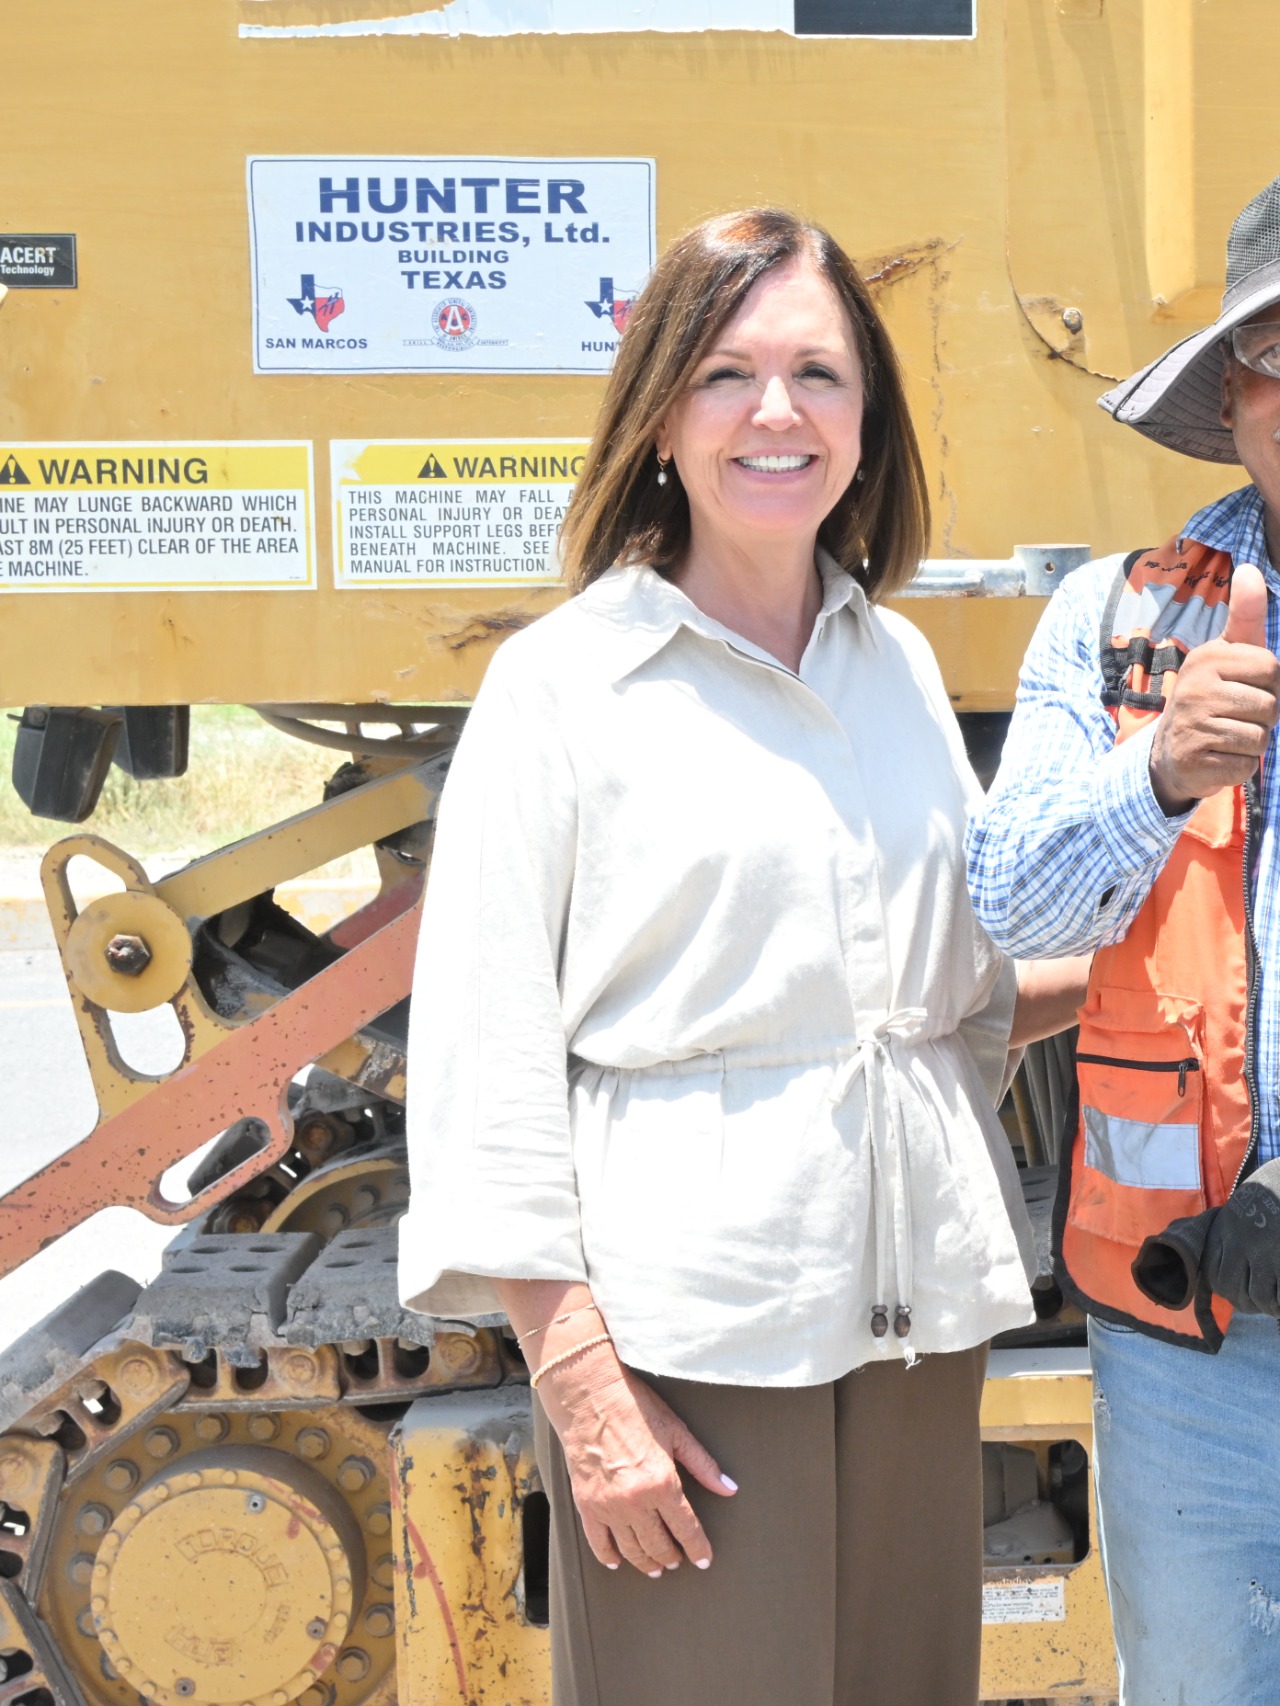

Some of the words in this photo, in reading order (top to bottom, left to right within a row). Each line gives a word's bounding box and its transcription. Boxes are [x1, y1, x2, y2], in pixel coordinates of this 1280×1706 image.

[319, 178, 587, 213] HUNTER
[296, 222, 530, 247] INDUSTRIES,
[545, 222, 609, 243] Ltd.
[0, 246, 57, 263] ACERT
[399, 250, 508, 263] BUILDING
[0, 264, 55, 277] Technology
[401, 271, 506, 289] TEXAS
[266, 338, 296, 348] SAN
[302, 338, 367, 349] MARCOS
[38, 458, 207, 484] WARNING
[0, 497, 25, 513] INE
[35, 497, 68, 512] MAY
[78, 497, 132, 512] LUNGE
[142, 496, 232, 512] BACKWARD
[242, 495, 296, 511] WHICH
[349, 491, 381, 504] THIS
[396, 490, 462, 504] MACHINE
[476, 490, 505, 503] MAY
[520, 490, 554, 502] FALL
[350, 508, 426, 521] PERSONAL
[439, 507, 491, 520] INJURY
[503, 507, 522, 520] OR
[534, 505, 568, 521] DEA
[0, 518, 28, 535] ULT
[34, 519, 49, 534] IN
[56, 518, 141, 533] PERSONAL
[212, 517, 234, 532] OR
[241, 516, 296, 532] DEATH.
[350, 525, 406, 539] INSTALL
[414, 525, 480, 538] SUPPORT
[487, 524, 522, 537] LEGS
[529, 523, 562, 538] BEF
[0, 539, 25, 556] ST
[29, 540, 53, 555] 8M
[59, 540, 83, 558] (25
[89, 539, 132, 558] FEET)
[138, 539, 189, 554] CLEAR
[196, 538, 215, 554] OF
[221, 538, 251, 553] THE
[257, 538, 298, 553] AREA
[351, 543, 415, 556] BENEATH
[433, 542, 505, 555] MACHINE.
[523, 541, 549, 554] SEE
[9, 561, 88, 576] MACHINE.
[351, 560, 411, 573] MANUAL
[417, 559, 444, 572] FOR
[451, 558, 550, 572] INSTRUCTION.
[174, 1528, 290, 1588] TORQUE
